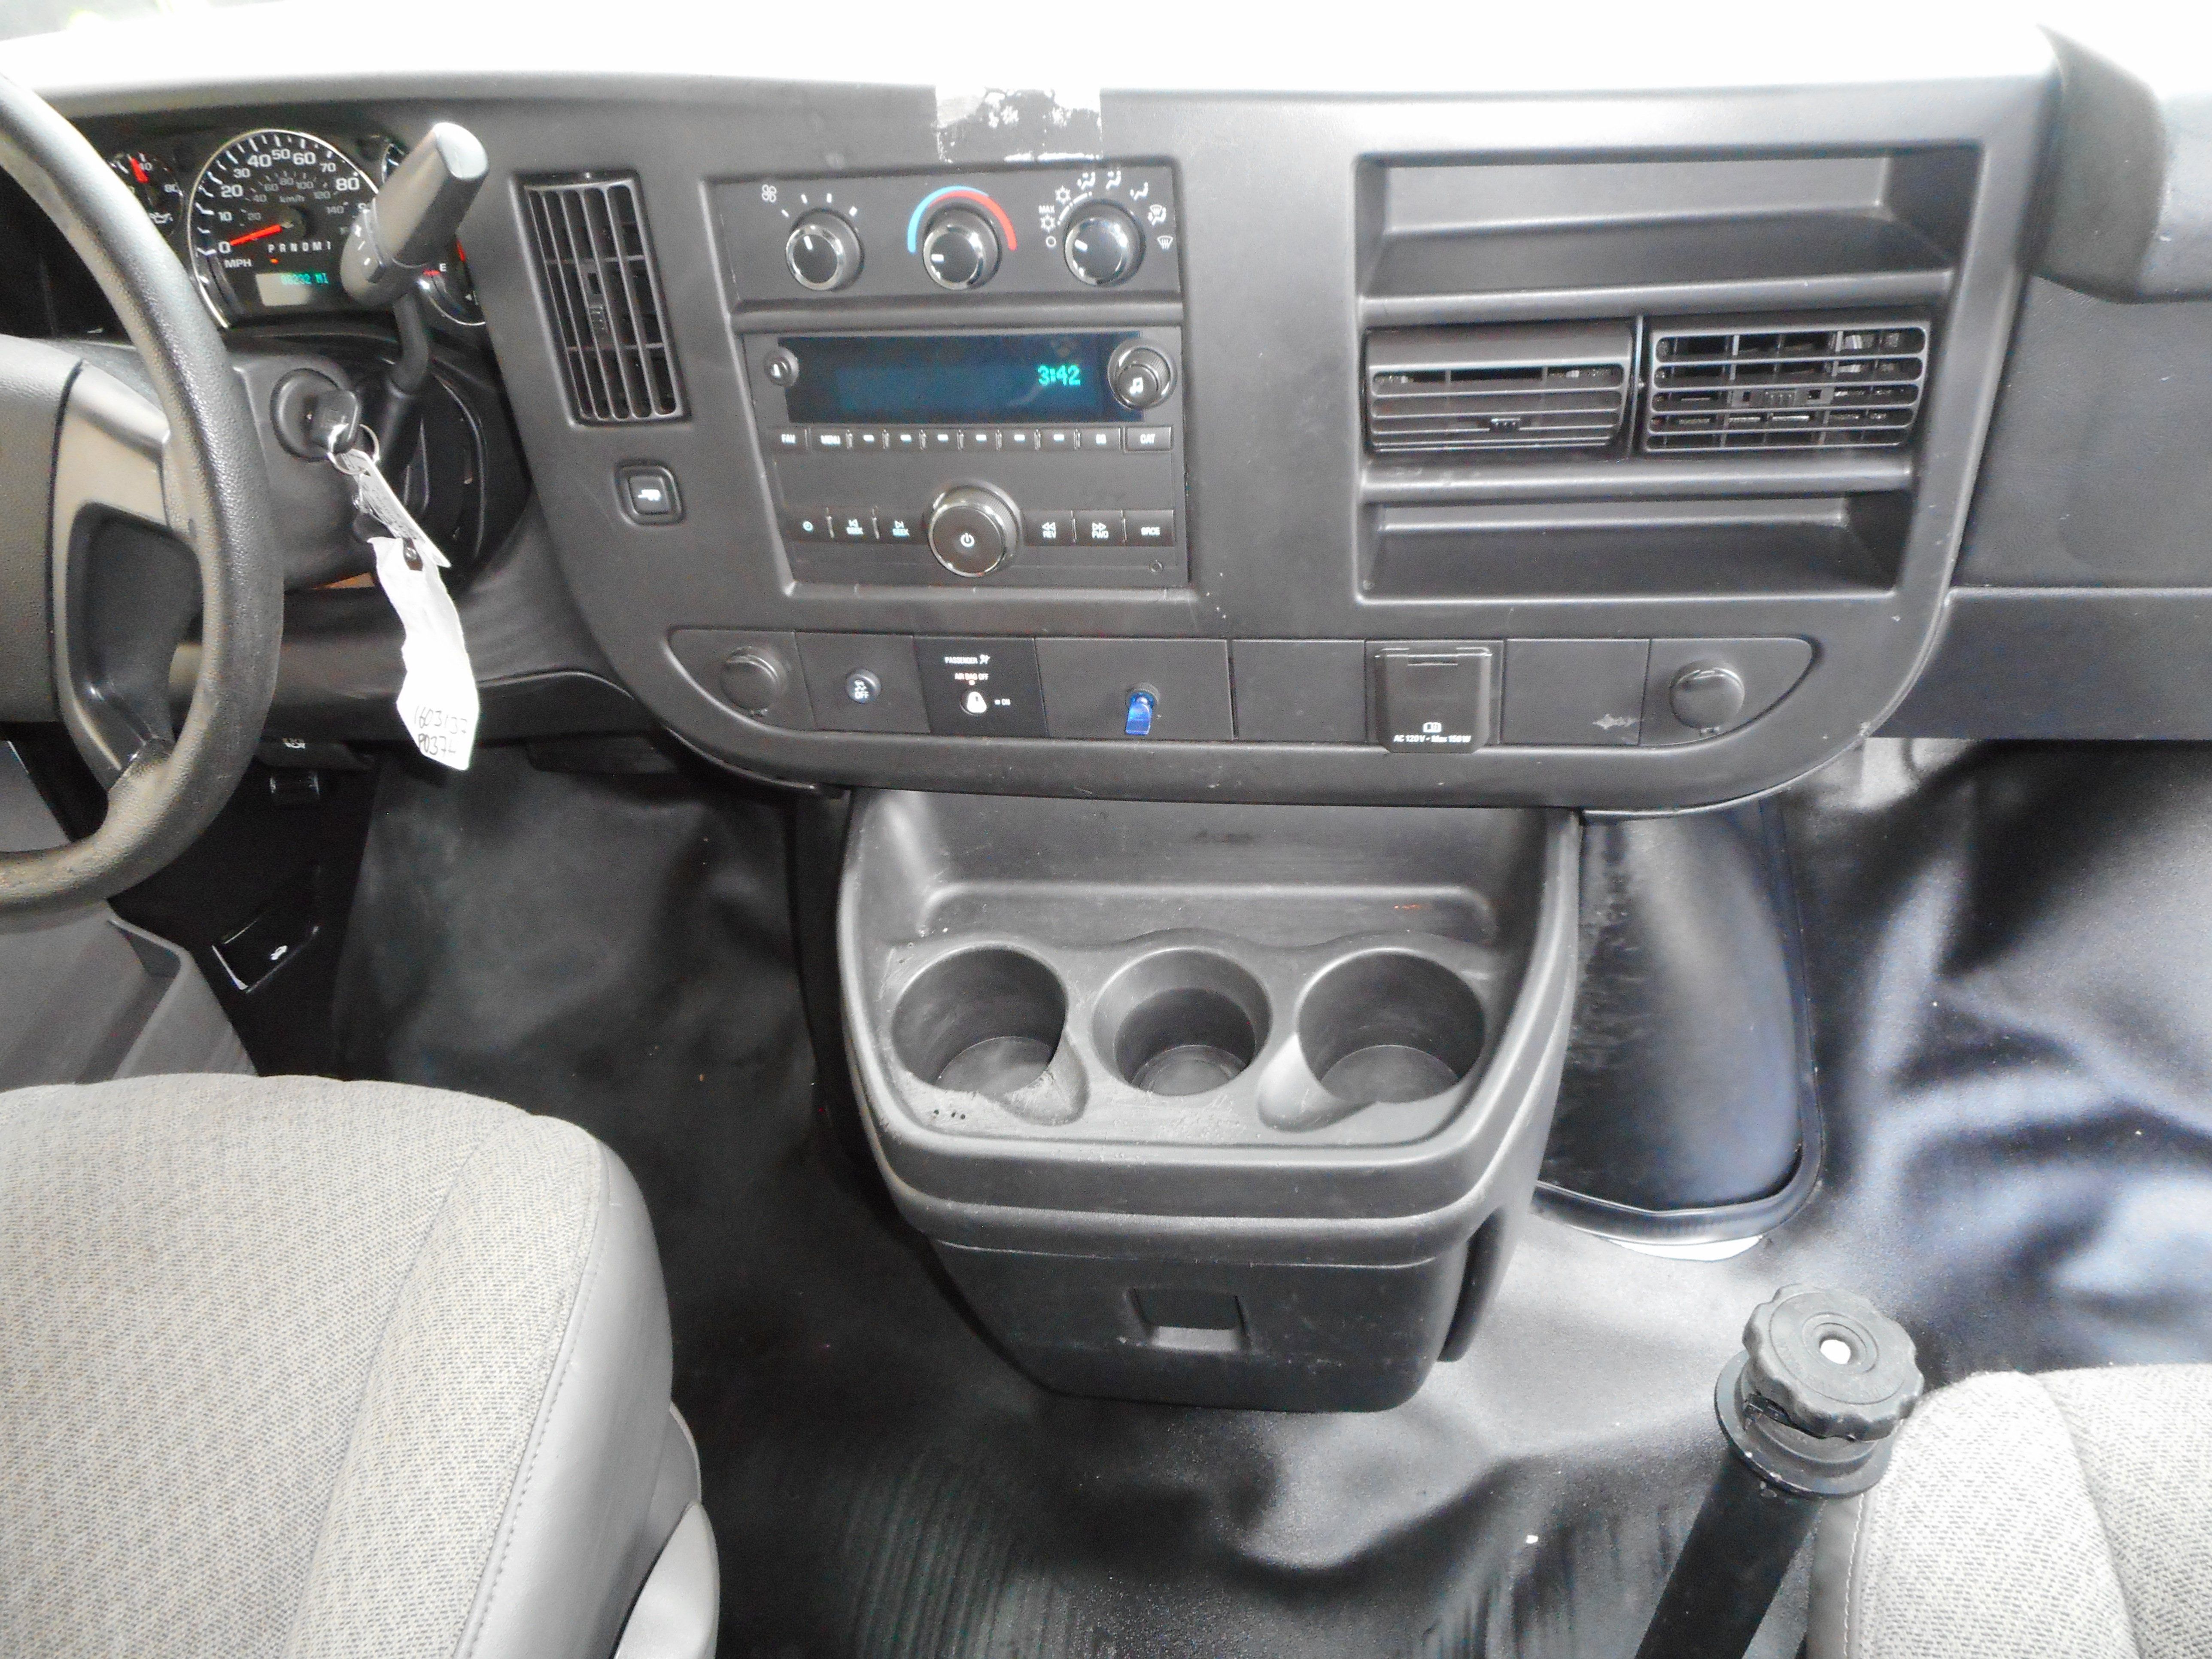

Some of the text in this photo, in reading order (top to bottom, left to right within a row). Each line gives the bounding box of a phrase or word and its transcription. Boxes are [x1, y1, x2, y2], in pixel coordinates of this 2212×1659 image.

[271, 149, 291, 160] 50
[293, 152, 316, 165] 60
[247, 154, 272, 167] 40
[320, 162, 336, 172] 70
[233, 168, 251, 179] 30
[296, 181, 314, 189] 100
[336, 177, 359, 191] 80
[221, 184, 243, 198] 20
[279, 195, 305, 203] km/h
[1039, 205, 1055, 213] MAX
[218, 211, 232, 222] 10
[218, 241, 231, 254] 0
[268, 244, 275, 253] P
[279, 243, 286, 252] R
[291, 243, 297, 252] N
[225, 258, 252, 268] MPH
[439, 263, 447, 271] E
[1038, 365, 1081, 386] 3:42
[781, 434, 796, 444] FAV
[820, 435, 841, 445] MENU
[1140, 434, 1156, 444] CAT
[1043, 530, 1056, 538] REV
[1092, 530, 1109, 538] FWD
[855, 691, 869, 699] OFF
